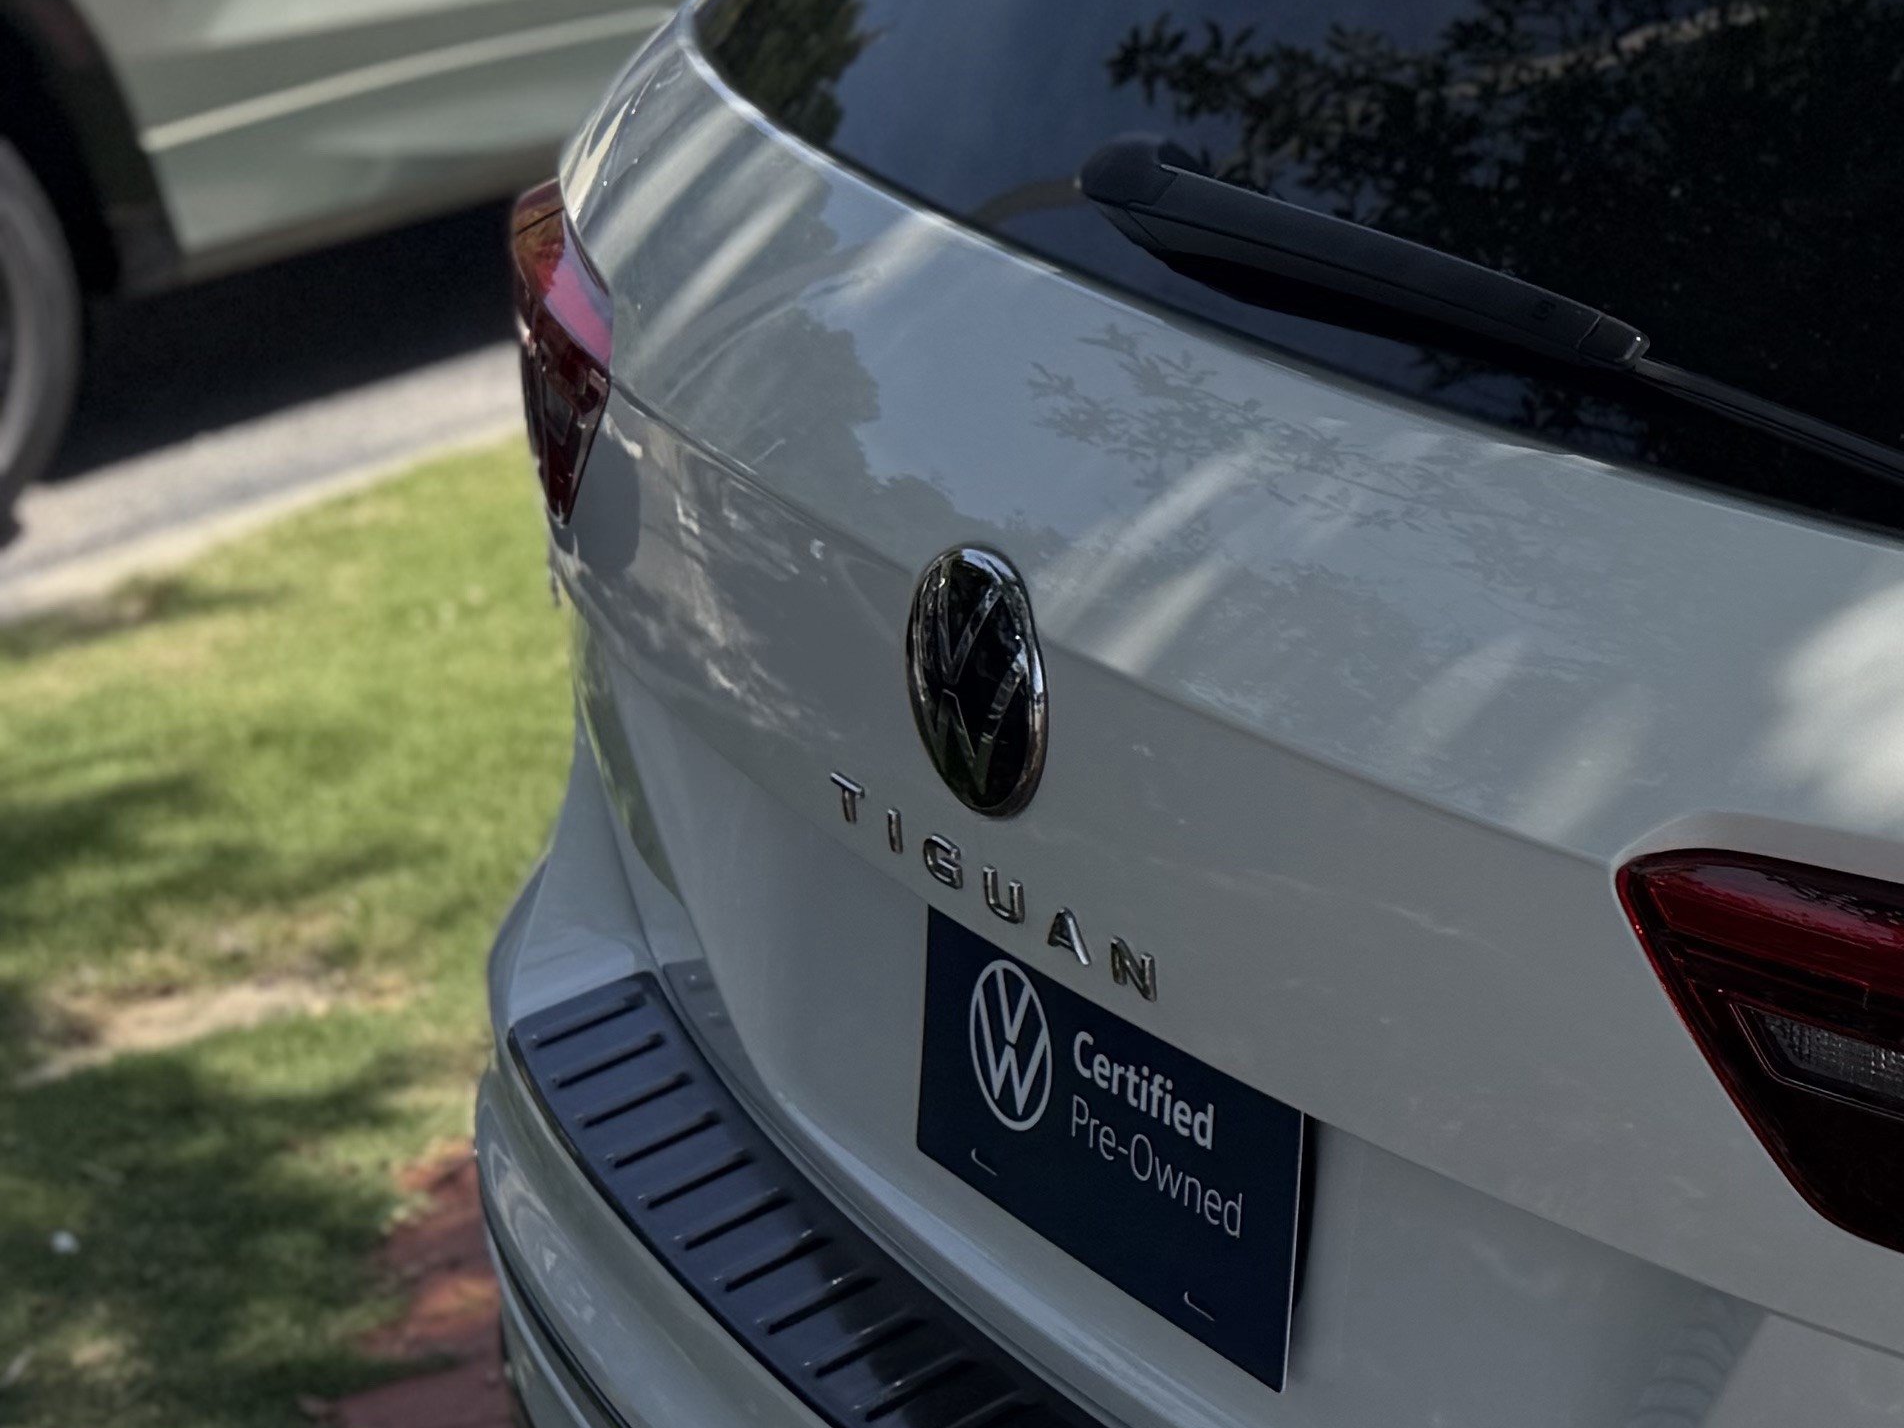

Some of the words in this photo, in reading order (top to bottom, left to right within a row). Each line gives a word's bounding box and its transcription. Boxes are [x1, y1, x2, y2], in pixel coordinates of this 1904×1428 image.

[829, 771, 1159, 1002] TIGUAN
[1073, 1031, 1215, 1150] Certified
[1071, 1094, 1243, 1238] Pre-Owned
